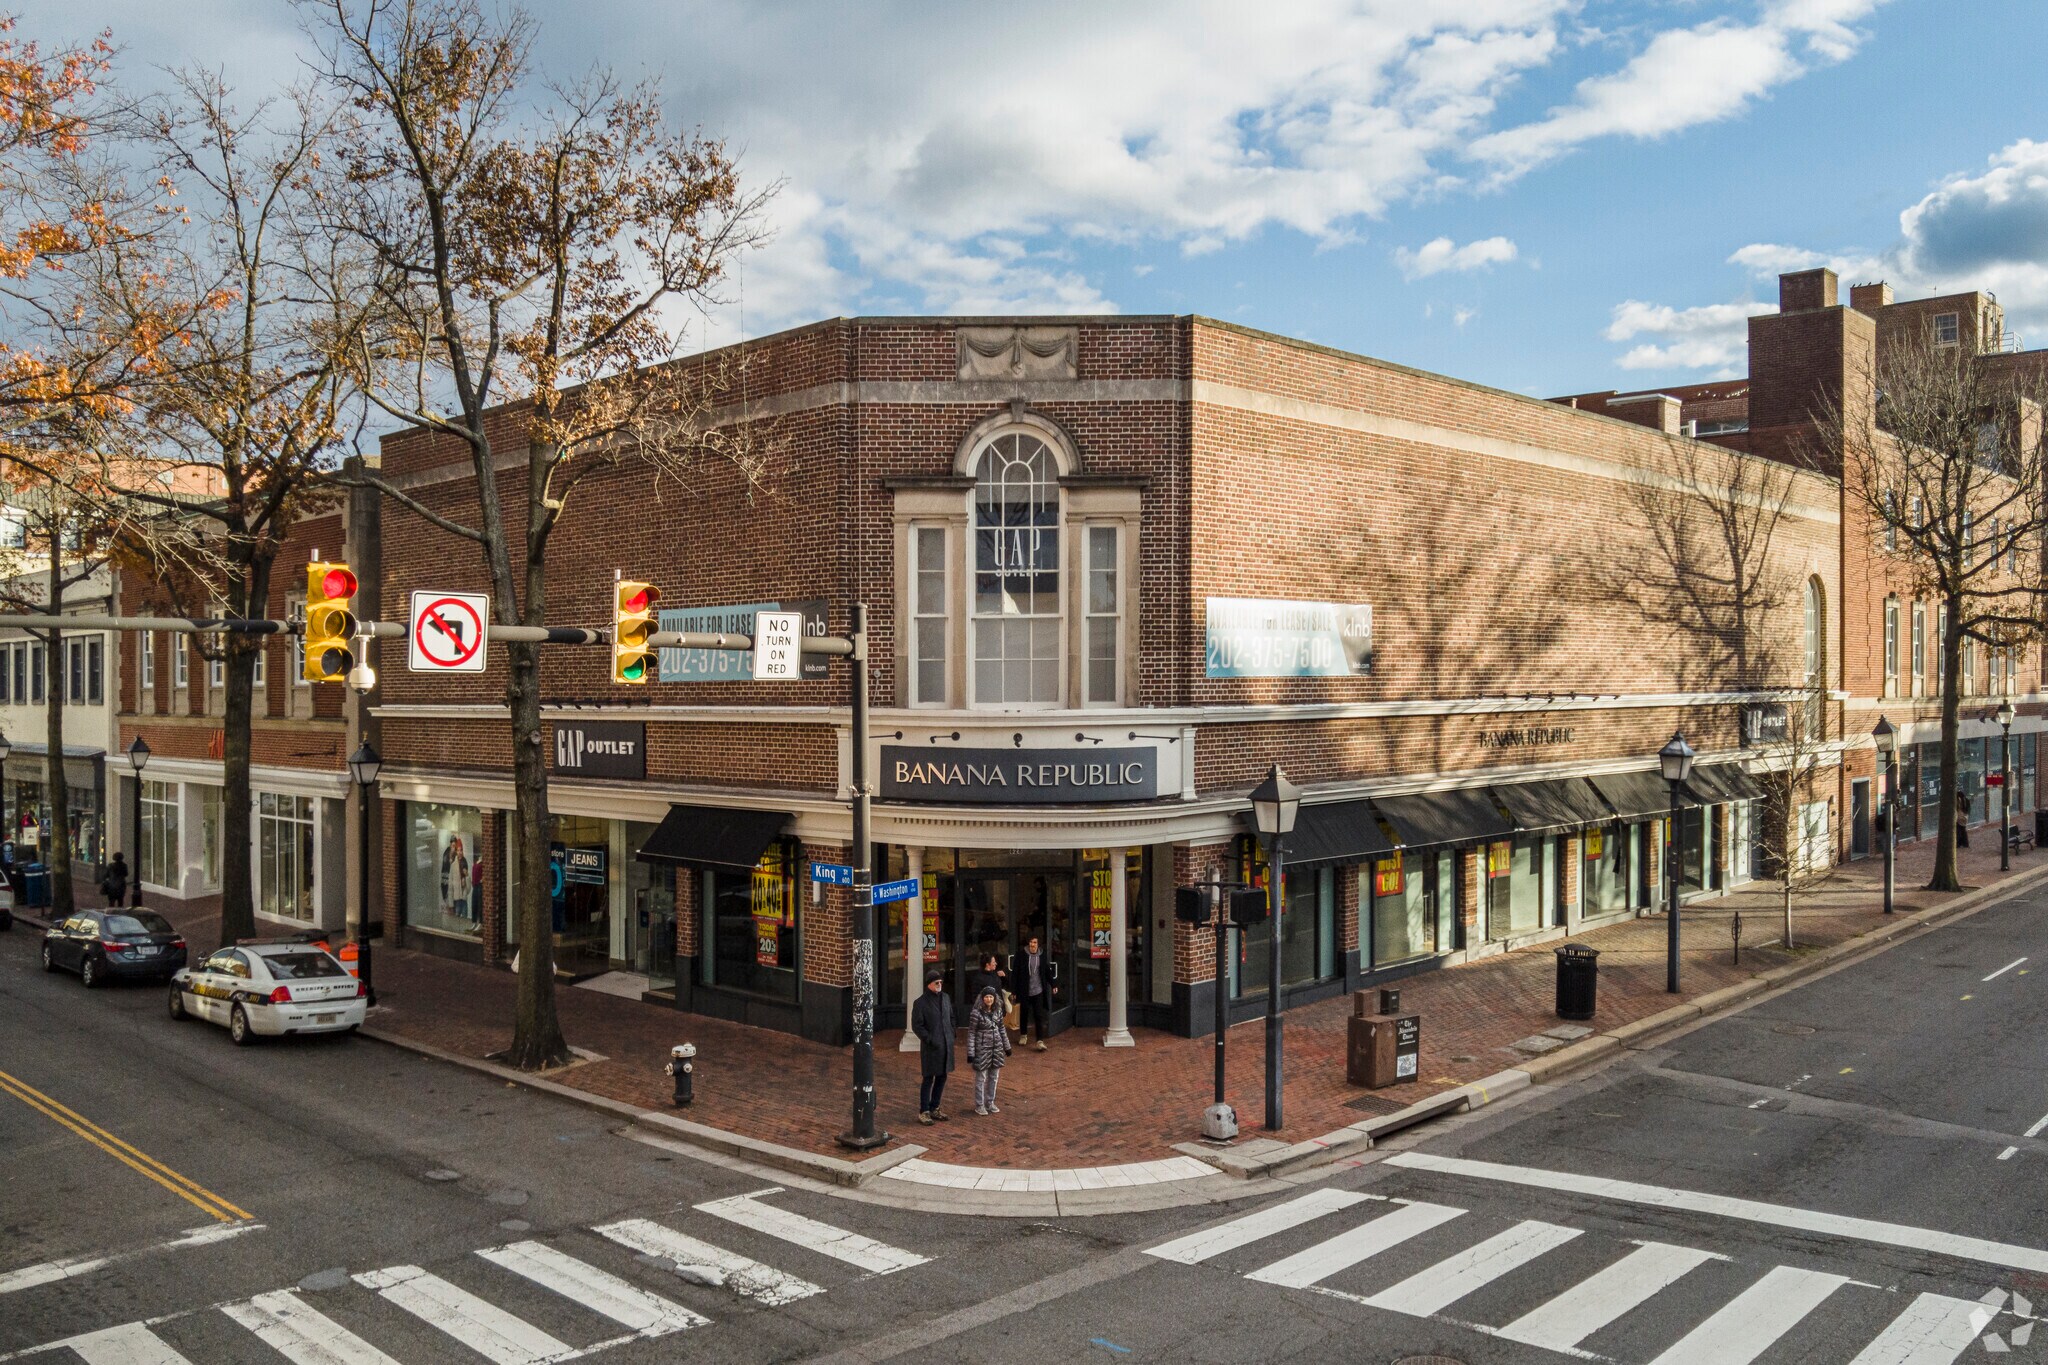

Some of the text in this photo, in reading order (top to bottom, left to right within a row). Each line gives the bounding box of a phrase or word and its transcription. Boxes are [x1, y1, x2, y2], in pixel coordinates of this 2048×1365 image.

[994, 528, 1041, 567] GAP
[995, 568, 1040, 577] OUTLET
[706, 614, 723, 635] FOR
[769, 619, 789, 632] NO
[802, 614, 826, 637] lnb
[1343, 616, 1370, 638] klnb
[766, 635, 792, 646] TURN
[661, 647, 754, 675] 202-375-75
[770, 650, 785, 660] ON
[1208, 635, 1332, 669] 202-375-7500
[767, 663, 787, 674] RED
[804, 664, 827, 672] klnb.com
[1479, 727, 1576, 748] BANANA REPUBLIC
[557, 729, 636, 768] GAP OUTLET
[895, 761, 1144, 787] BANANA REPUBLIC
[571, 853, 598, 867] JEANS
[815, 864, 836, 883] King
[1093, 870, 1111, 886] STO
[1382, 871, 1400, 892] GO!
[879, 883, 909, 899] Washington
[1093, 888, 1111, 909] CLOS
